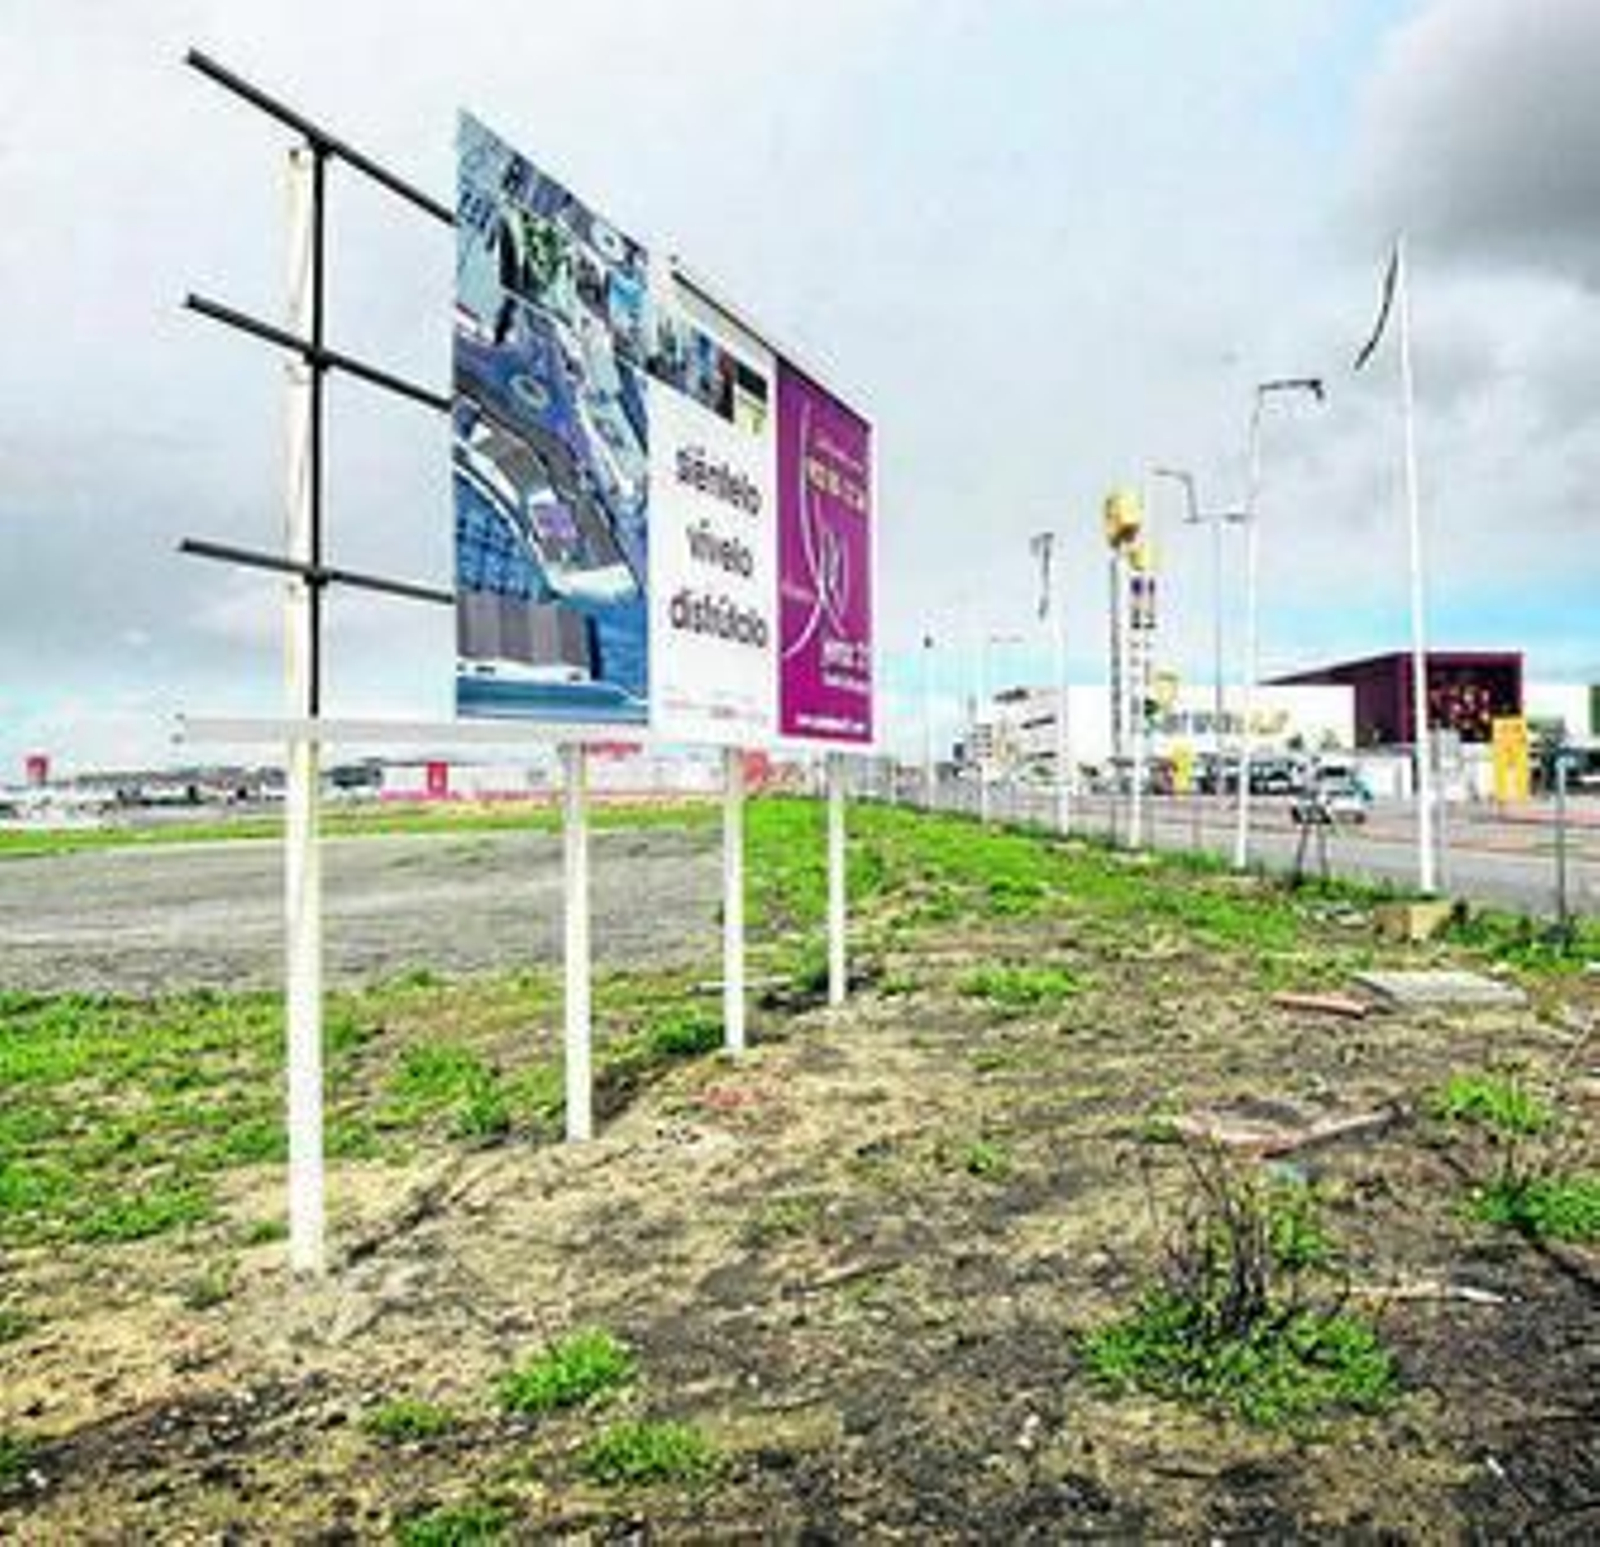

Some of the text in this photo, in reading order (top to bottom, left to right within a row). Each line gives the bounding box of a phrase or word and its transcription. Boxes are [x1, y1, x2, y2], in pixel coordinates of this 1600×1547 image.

[675, 446, 763, 516] siéntelo
[686, 517, 752, 578] vívelo
[669, 588, 768, 649] disfrútalo
